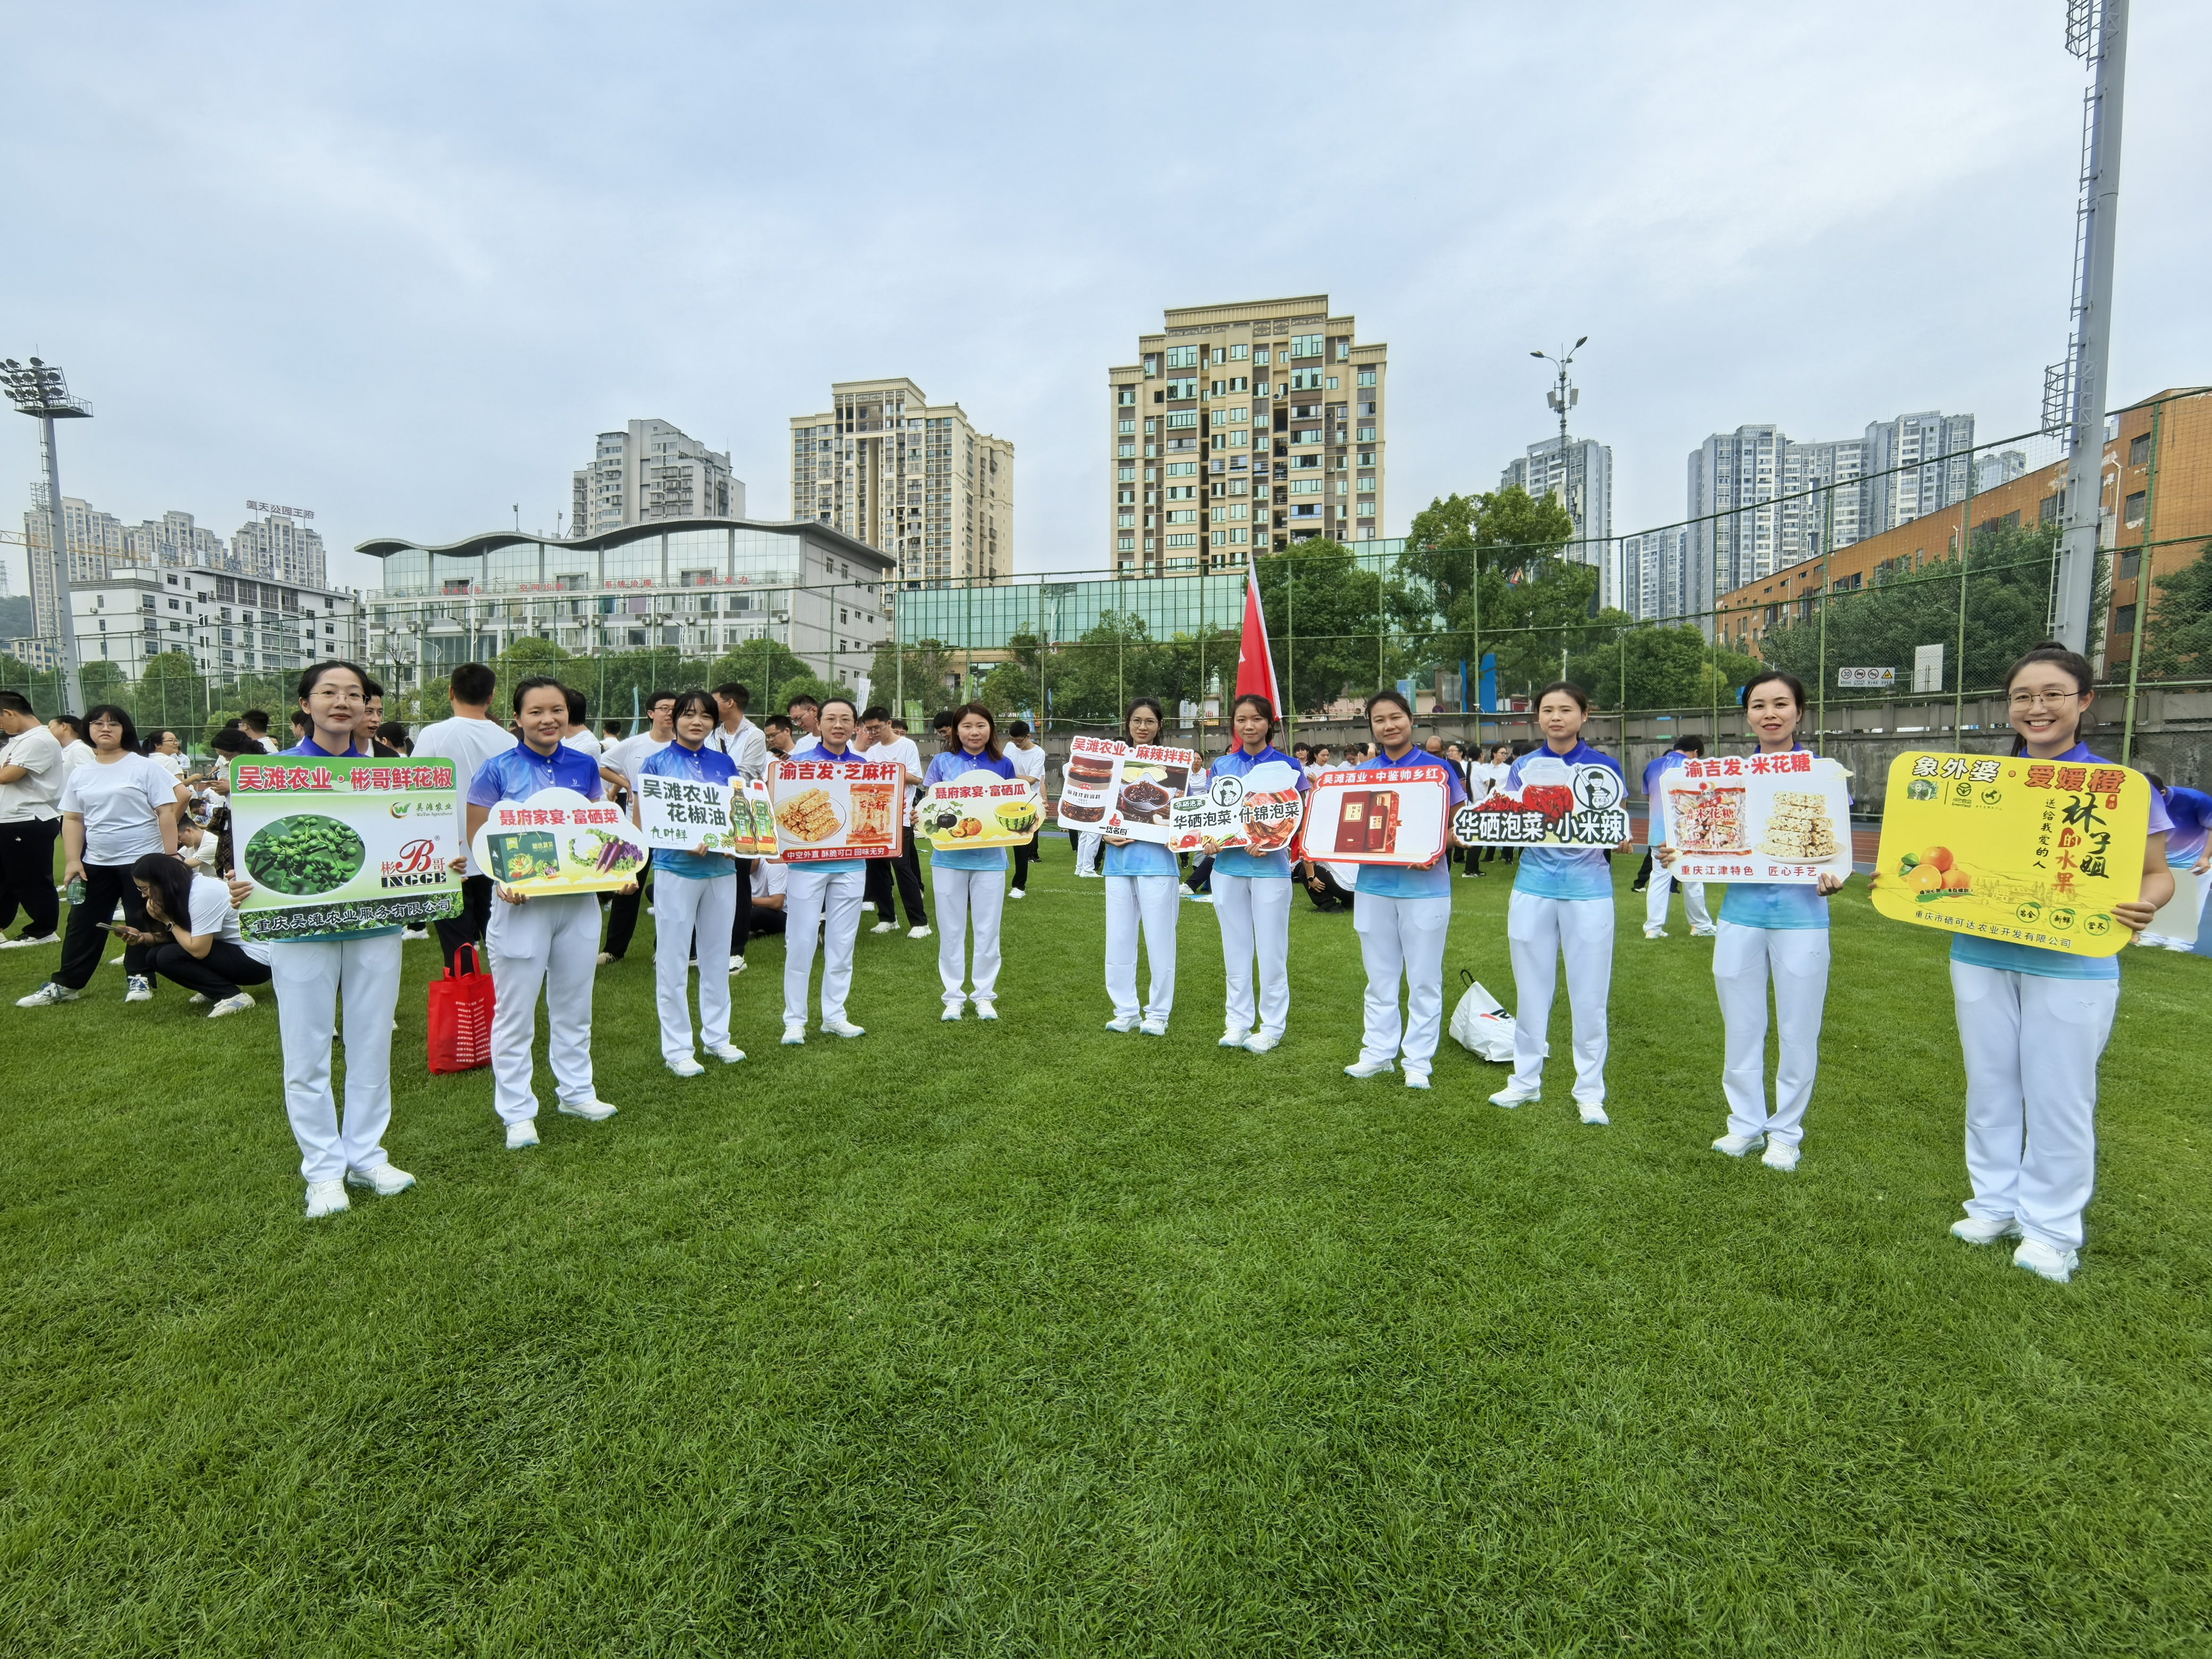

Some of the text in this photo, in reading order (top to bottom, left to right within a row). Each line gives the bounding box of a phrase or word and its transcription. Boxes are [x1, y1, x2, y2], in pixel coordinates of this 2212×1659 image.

[1685, 754, 1811, 777] 渝吉发·米花糖
[643, 778, 721, 806] 吴滩农业
[666, 802, 726, 826] 花椒油
[650, 826, 688, 842] 九叶鲜
[1681, 866, 1817, 877] 重庆江津特色 匠心手艺
[253, 899, 451, 934] 重庆吴滩农业服务有限公司
